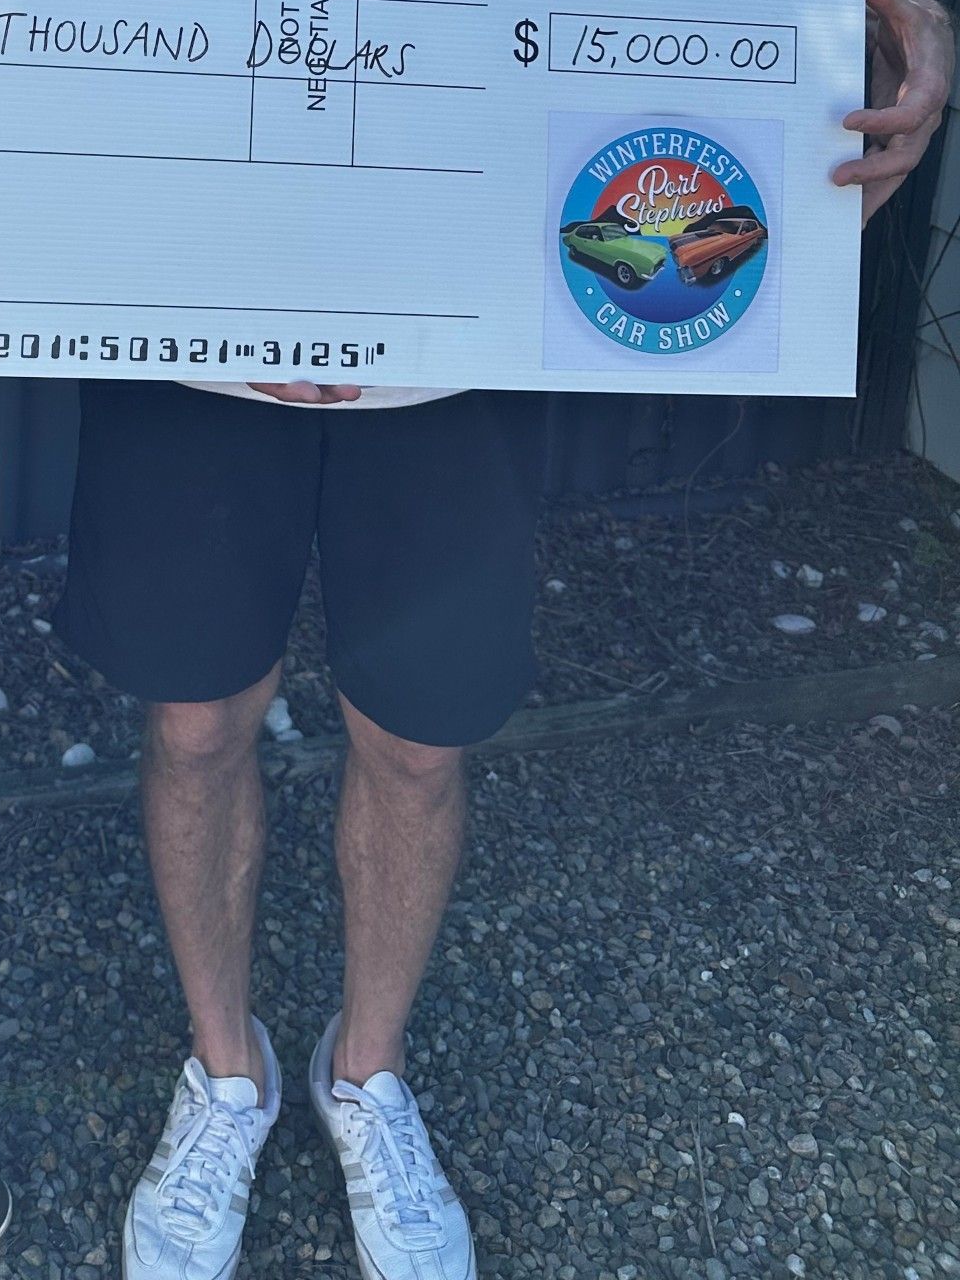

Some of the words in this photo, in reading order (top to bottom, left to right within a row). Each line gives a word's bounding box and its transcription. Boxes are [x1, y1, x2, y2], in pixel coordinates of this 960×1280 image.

[280, 1, 300, 55] NOT
[513, 18, 539, 68] $
[588, 133, 744, 186] WINTERFEST
[637, 164, 703, 207] Port
[616, 193, 726, 234] Stephens
[596, 301, 646, 346] CAR
[659, 302, 731, 350] SHOW
